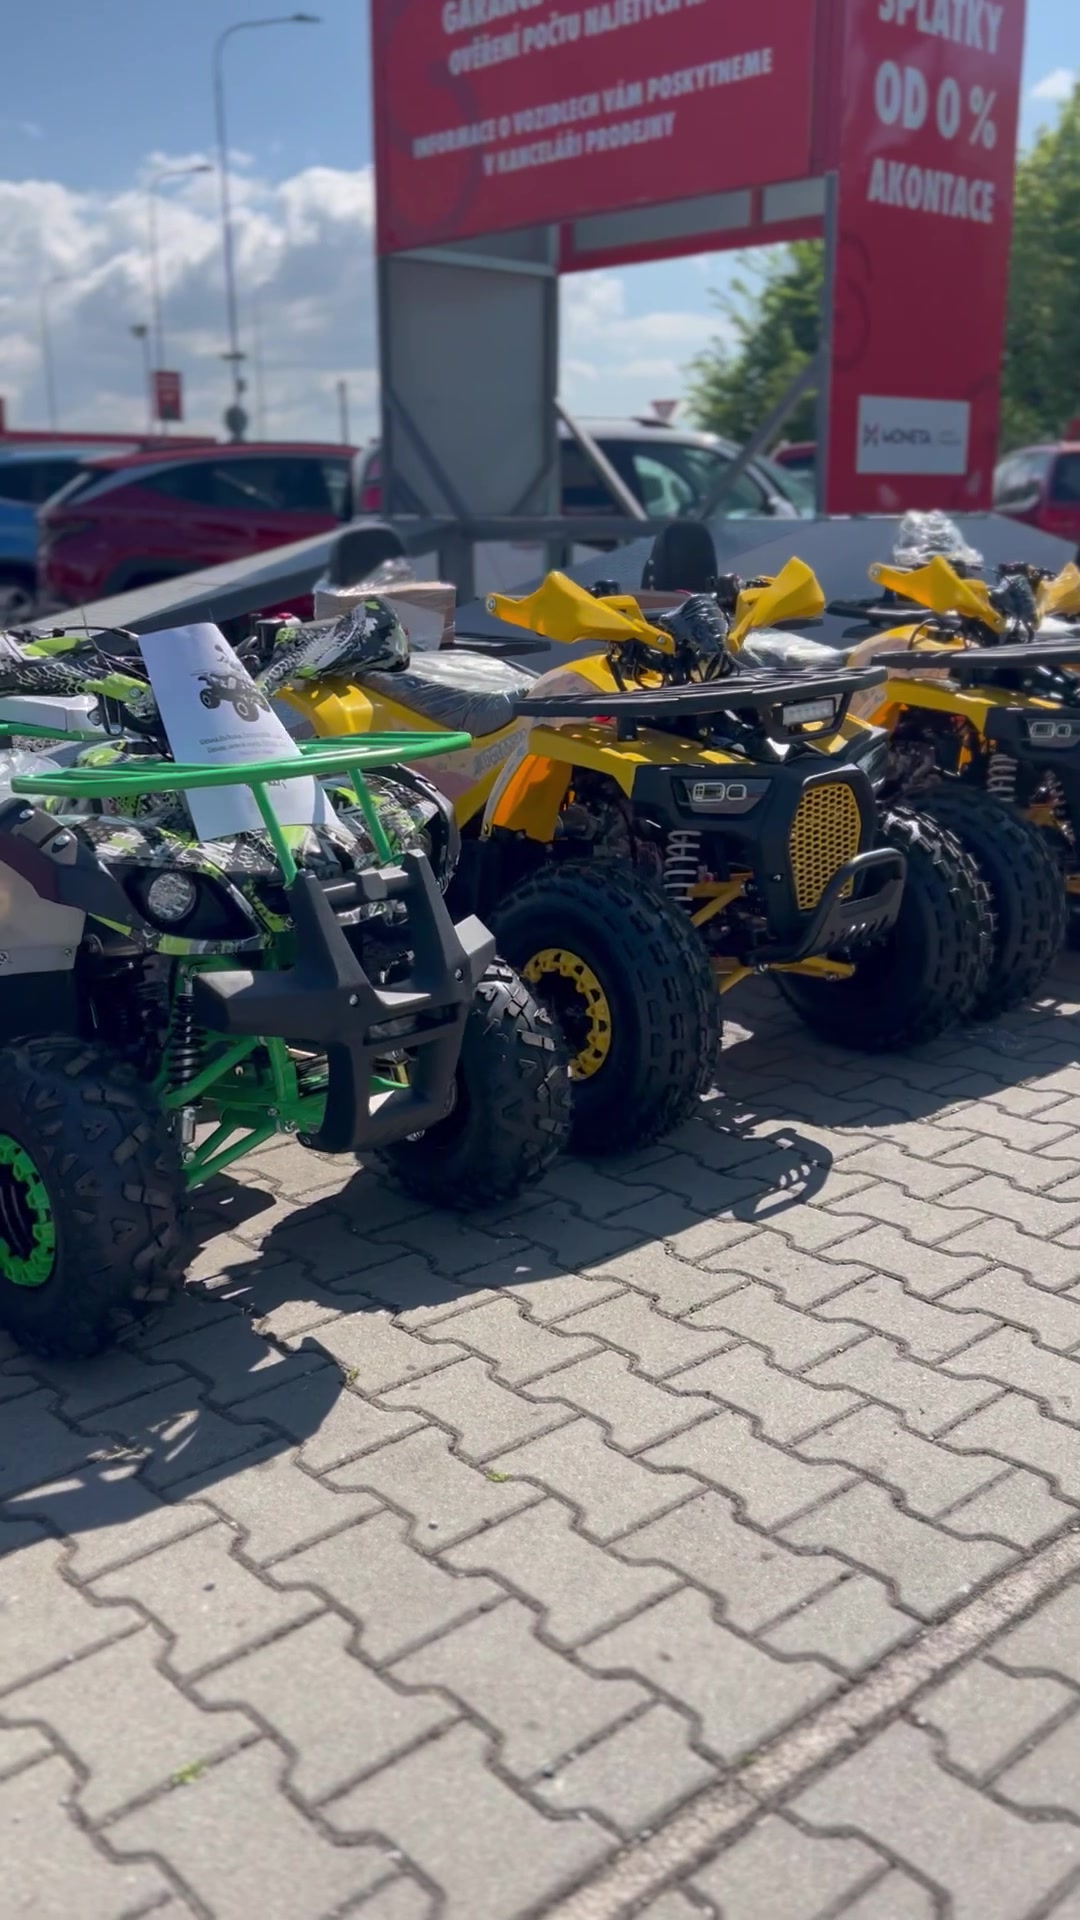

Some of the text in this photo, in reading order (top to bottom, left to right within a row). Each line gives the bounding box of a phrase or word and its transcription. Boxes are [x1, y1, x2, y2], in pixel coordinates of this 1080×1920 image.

[441, 0, 545, 34] GARAN
[523, 11, 581, 53] POČTU
[412, 47, 773, 160] INFORMACE O VOZIDLECH VÁM POSKYTNEME
[875, 60, 928, 130] OD
[483, 154, 495, 176] V
[585, 111, 676, 154] PRODEJNY
[867, 157, 995, 224] AKONTACE
